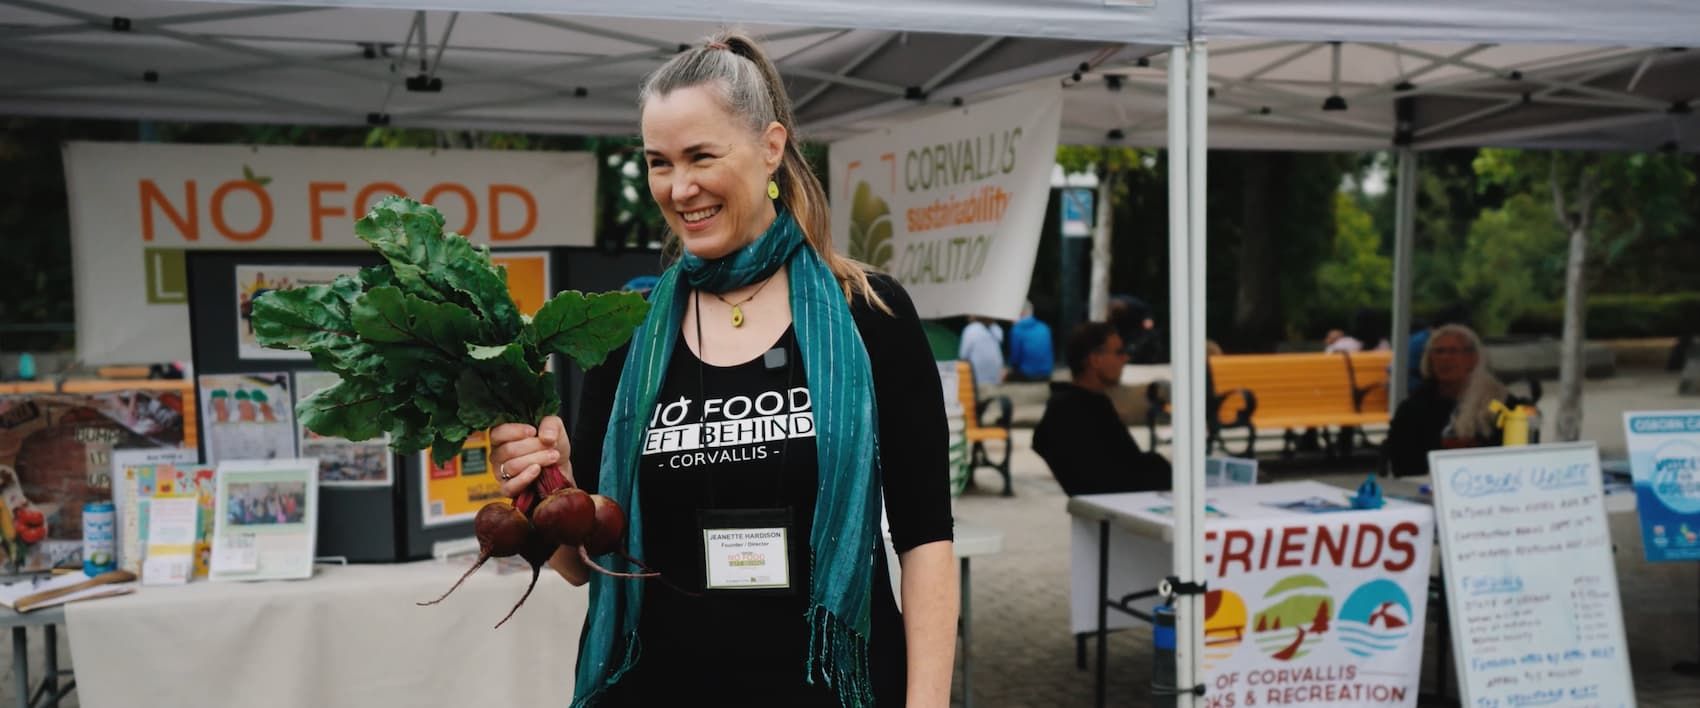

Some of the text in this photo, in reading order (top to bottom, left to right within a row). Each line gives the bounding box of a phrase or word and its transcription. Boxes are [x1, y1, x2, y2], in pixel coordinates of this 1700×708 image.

[905, 127, 1022, 192] CORVALLIS
[138, 179, 274, 242] NO
[701, 387, 812, 421] FOOD
[646, 416, 814, 451] EFT BEHIND
[670, 446, 768, 469] CORVALLIS
[710, 532, 781, 541] JEANETTE HARDISON
[1216, 665, 1357, 690] OF CORVALLIS
[1244, 689, 1256, 706] &
[1267, 684, 1407, 704] RECREATION
